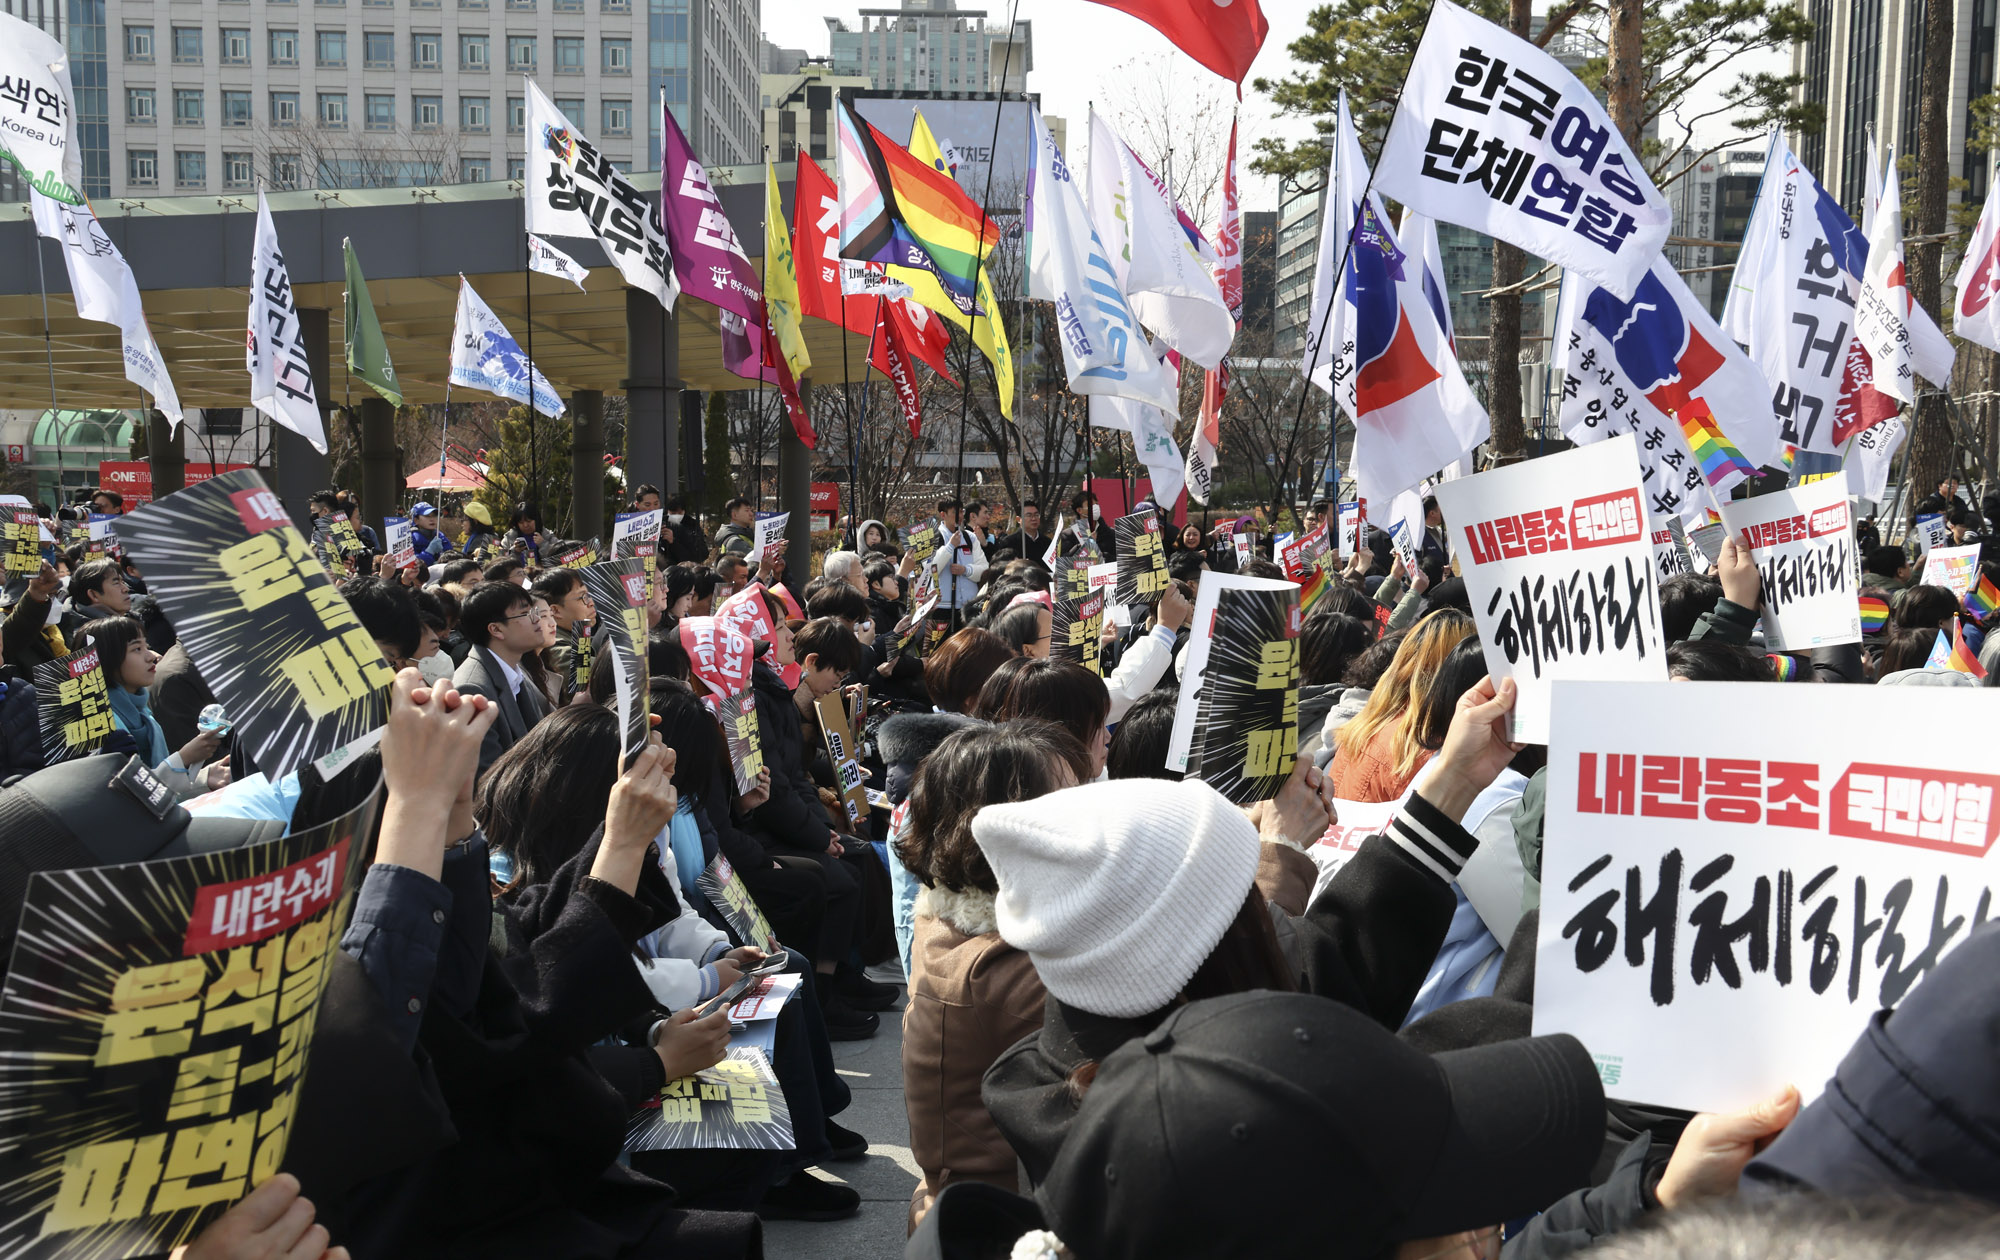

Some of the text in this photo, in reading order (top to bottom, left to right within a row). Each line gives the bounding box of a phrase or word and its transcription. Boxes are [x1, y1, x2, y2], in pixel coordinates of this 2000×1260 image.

[1, 116, 45, 142] Korea
[1732, 152, 1765, 161] KOREA
[1421, 118, 1638, 255] 단체연합
[1056, 292, 1093, 360] 경기도당
[124, 345, 156, 372] 중앙대학
[110, 471, 135, 483] ONE
[18, 513, 39, 524] 내란수
[1464, 510, 1568, 565] 내란동조
[1575, 494, 1639, 543] 국민의힘
[1741, 515, 1807, 550] 내란동조
[1488, 555, 1658, 678] 해체하라!
[1577, 752, 1992, 848] 내란동조 국민의힘
[39, 1095, 302, 1237] 파면하
